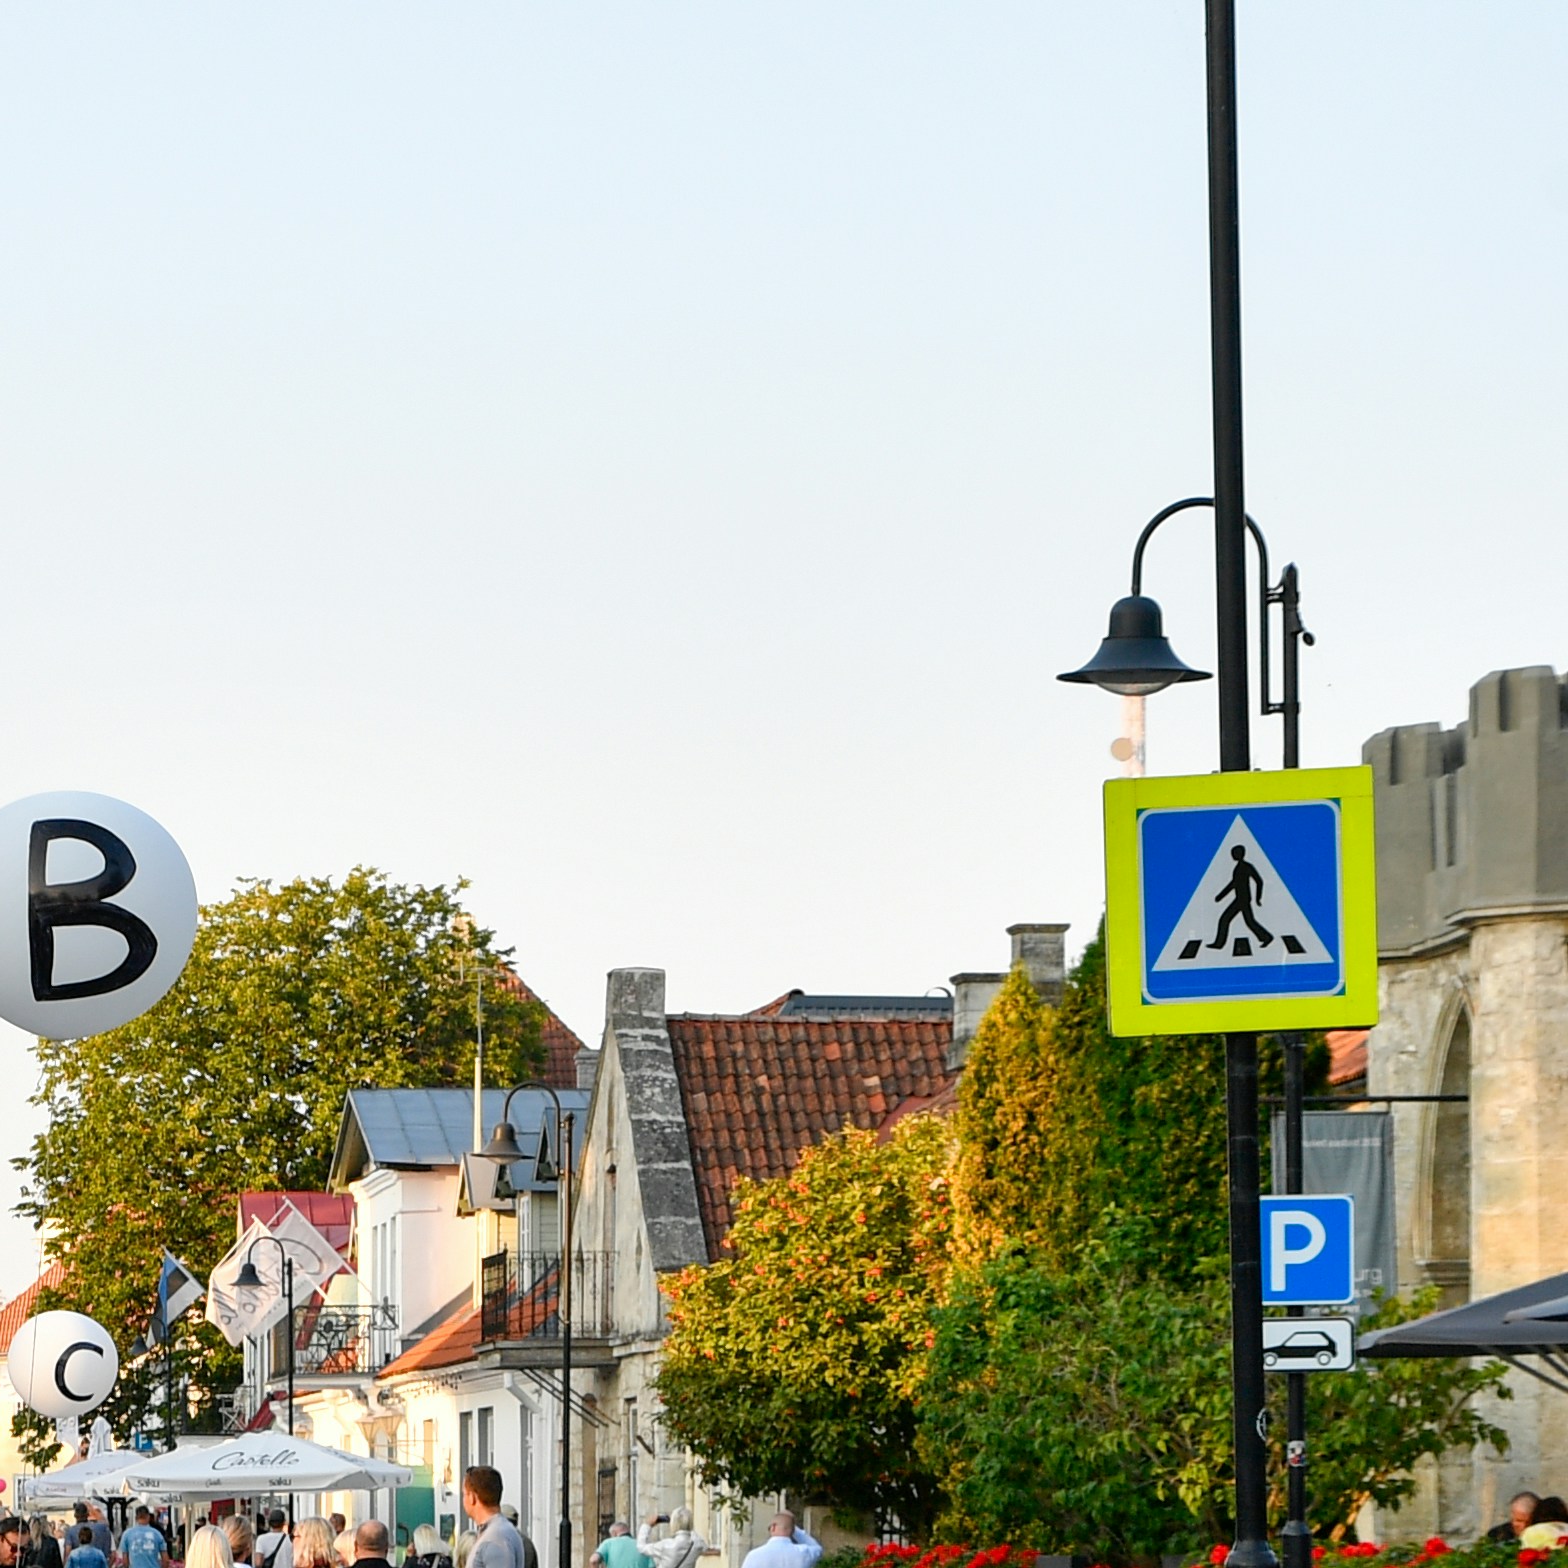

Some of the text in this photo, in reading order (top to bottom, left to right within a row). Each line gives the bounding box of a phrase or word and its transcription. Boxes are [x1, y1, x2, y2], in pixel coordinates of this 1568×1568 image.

[28, 818, 158, 1001] B
[1270, 1211, 1326, 1291] P
[54, 1341, 103, 1402] C
